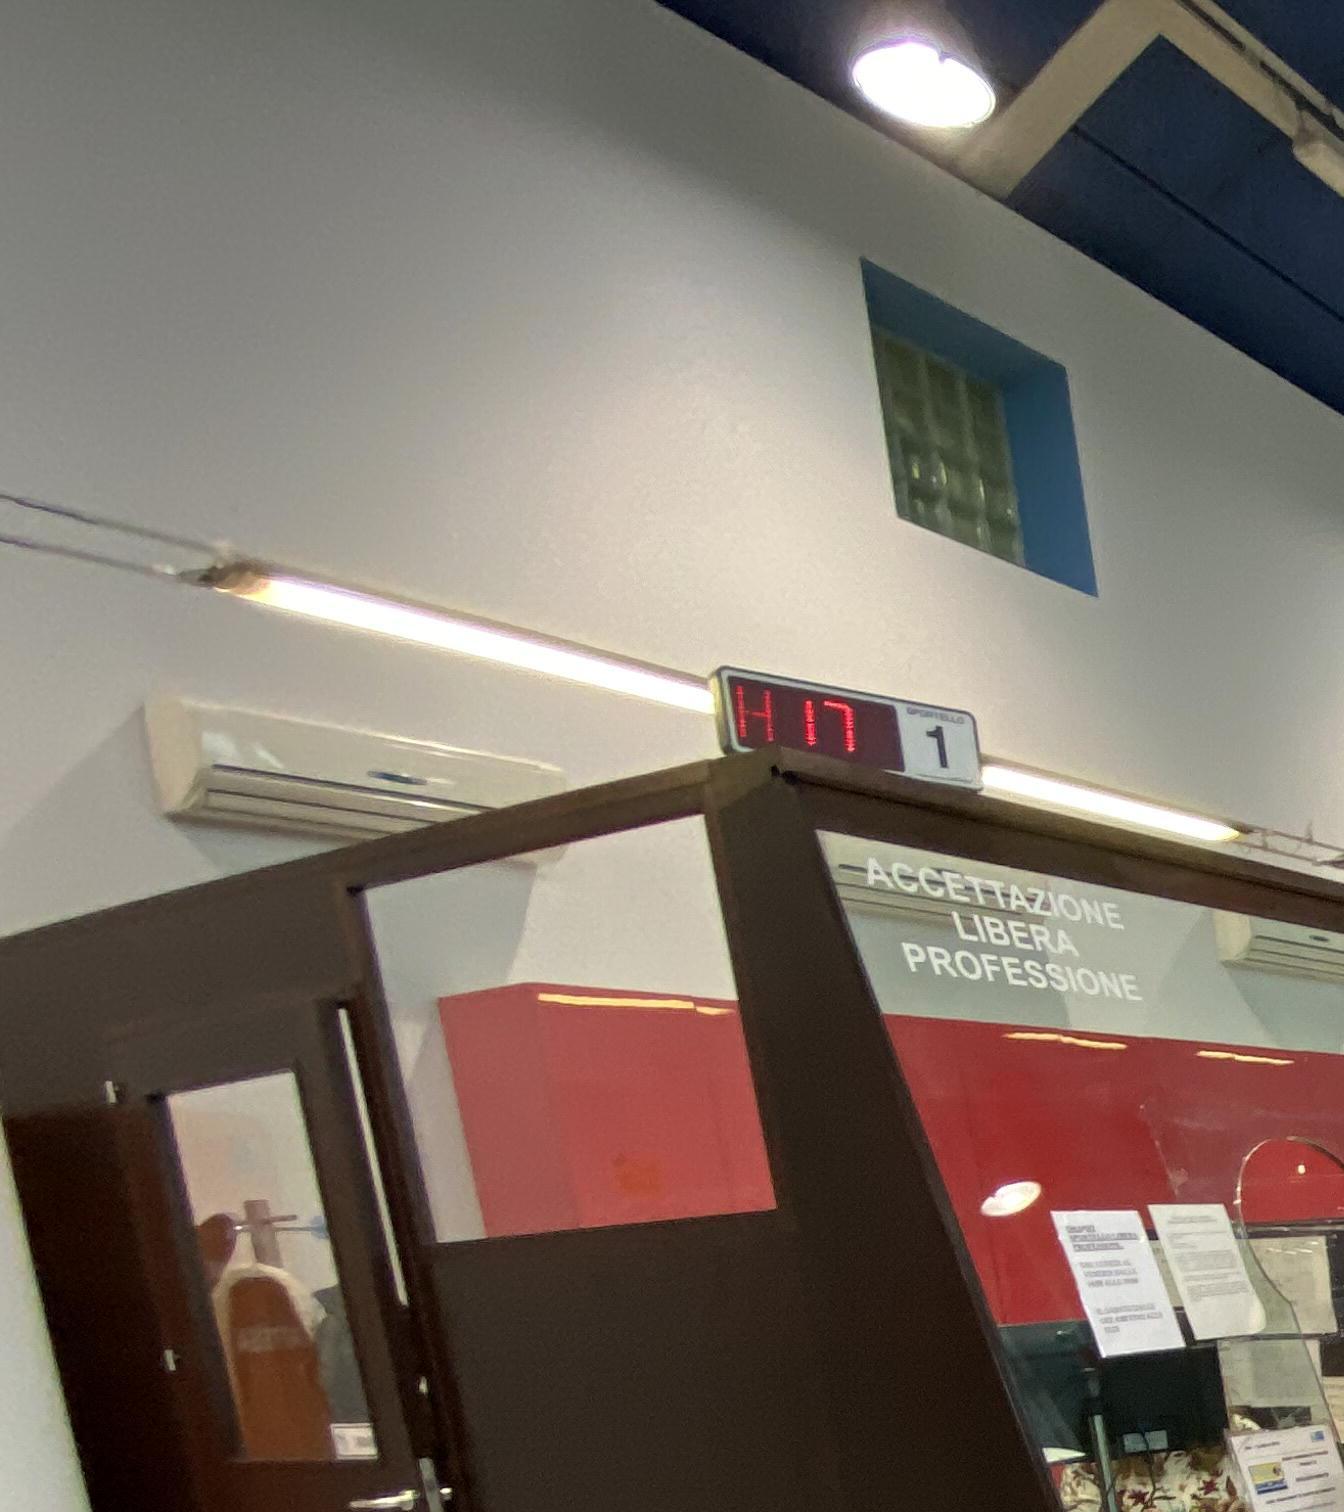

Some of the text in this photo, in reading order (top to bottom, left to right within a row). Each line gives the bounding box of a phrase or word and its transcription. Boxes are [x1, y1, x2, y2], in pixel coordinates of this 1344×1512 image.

[926, 725, 948, 768] 1
[866, 856, 1125, 930] ACCETTAZIONE
[951, 911, 1080, 957] LIBERA
[901, 941, 1143, 1001] PROFESSIONE
